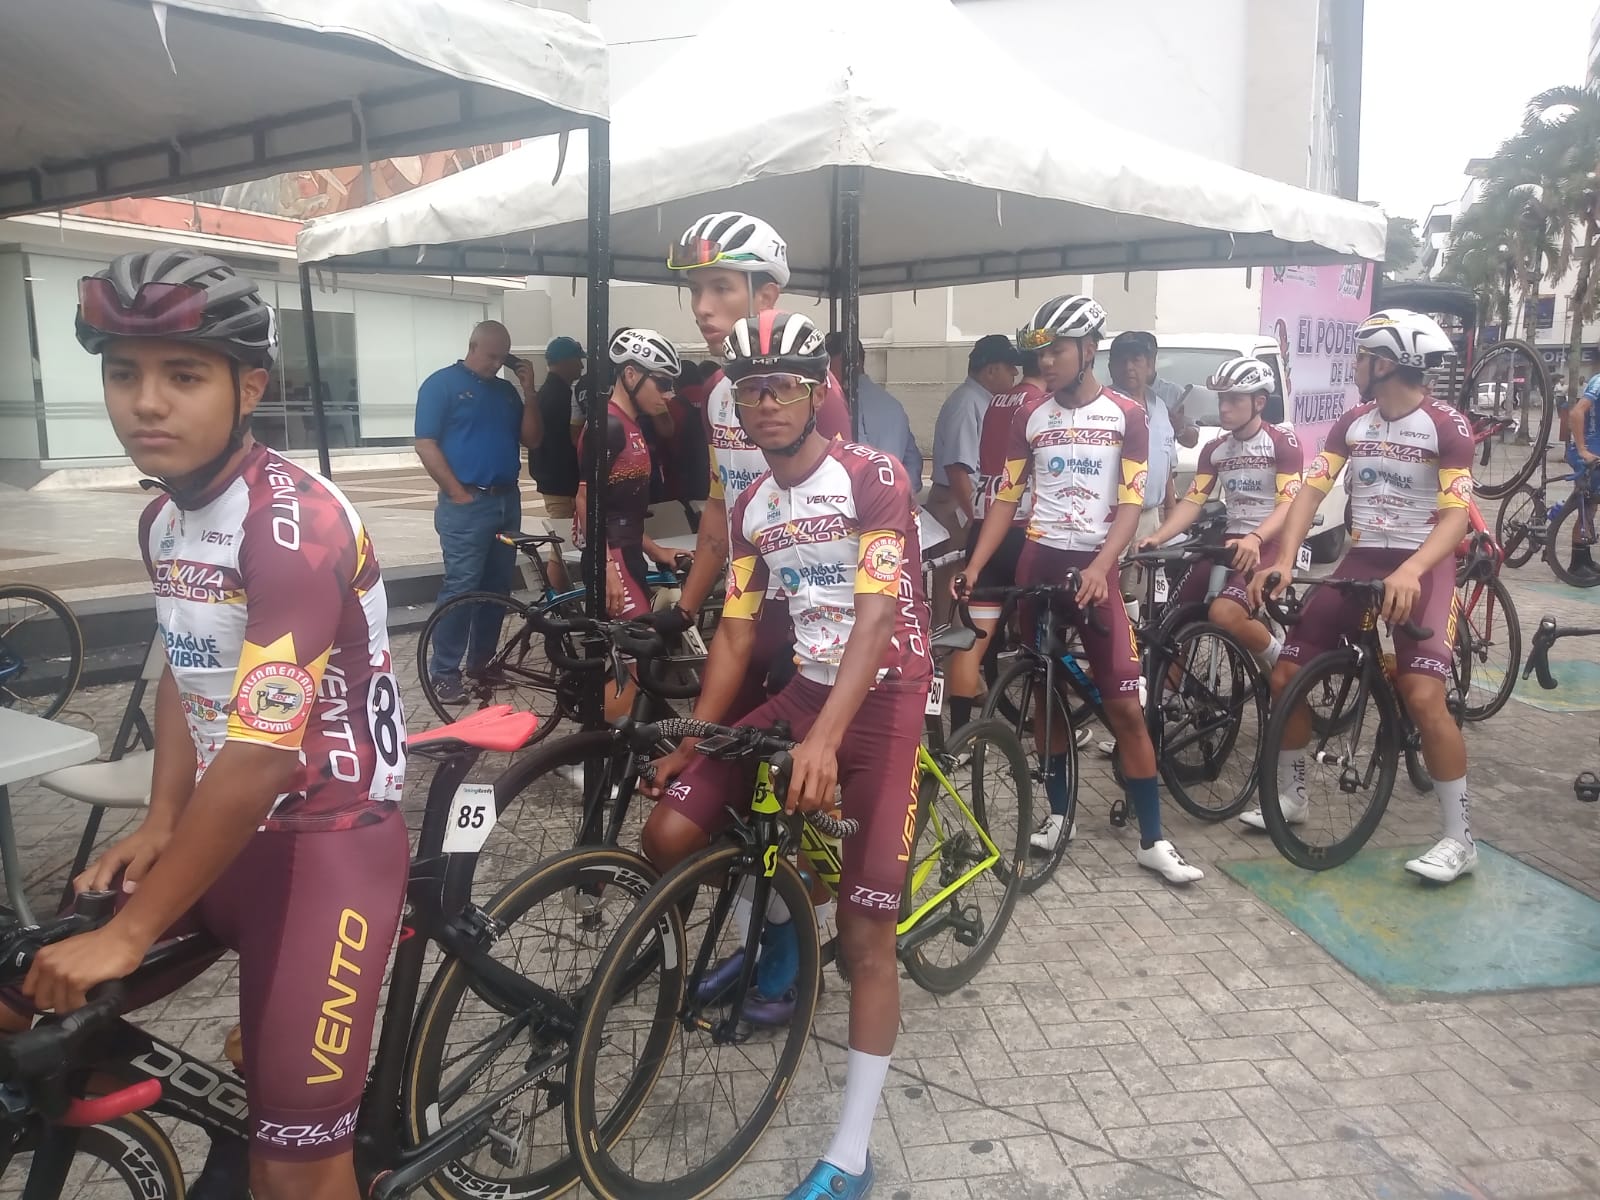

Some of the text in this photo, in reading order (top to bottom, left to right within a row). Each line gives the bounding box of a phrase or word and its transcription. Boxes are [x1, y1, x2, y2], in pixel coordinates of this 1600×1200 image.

[1298, 318, 1312, 354] EL
[631, 343, 652, 358] 99
[1400, 352, 1423, 367] 83
[1331, 362, 1341, 383] DE
[1086, 414, 1119, 422] VENTO
[1294, 393, 1344, 424] MUJERES
[1432, 401, 1470, 438] VENTO
[1039, 429, 1113, 442] TOLIMA
[1057, 438, 1113, 447] PASION
[1400, 430, 1431, 440] VENTO
[1354, 442, 1423, 458] TOLIMA
[843, 442, 895, 486] VENTO
[1069, 466, 1100, 476] VIBRA
[264, 461, 300, 552] VENTO
[806, 494, 848, 505] VENTO
[200, 529, 233, 546] VENT
[759, 516, 846, 546] TOLIMA
[760, 529, 848, 554] ES PASION
[806, 573, 848, 587] VIBRA
[166, 631, 220, 654] BAGUÉ
[239, 665, 314, 704] SALSAMENTARIA
[252, 719, 293, 732] TOVAR
[457, 804, 486, 829] 85
[850, 894, 874, 908] ES
[305, 906, 369, 1086] VENTO
[130, 1040, 249, 1121] DOG
[259, 1105, 361, 1138] TOLIM
[256, 1132, 288, 1147] ES
